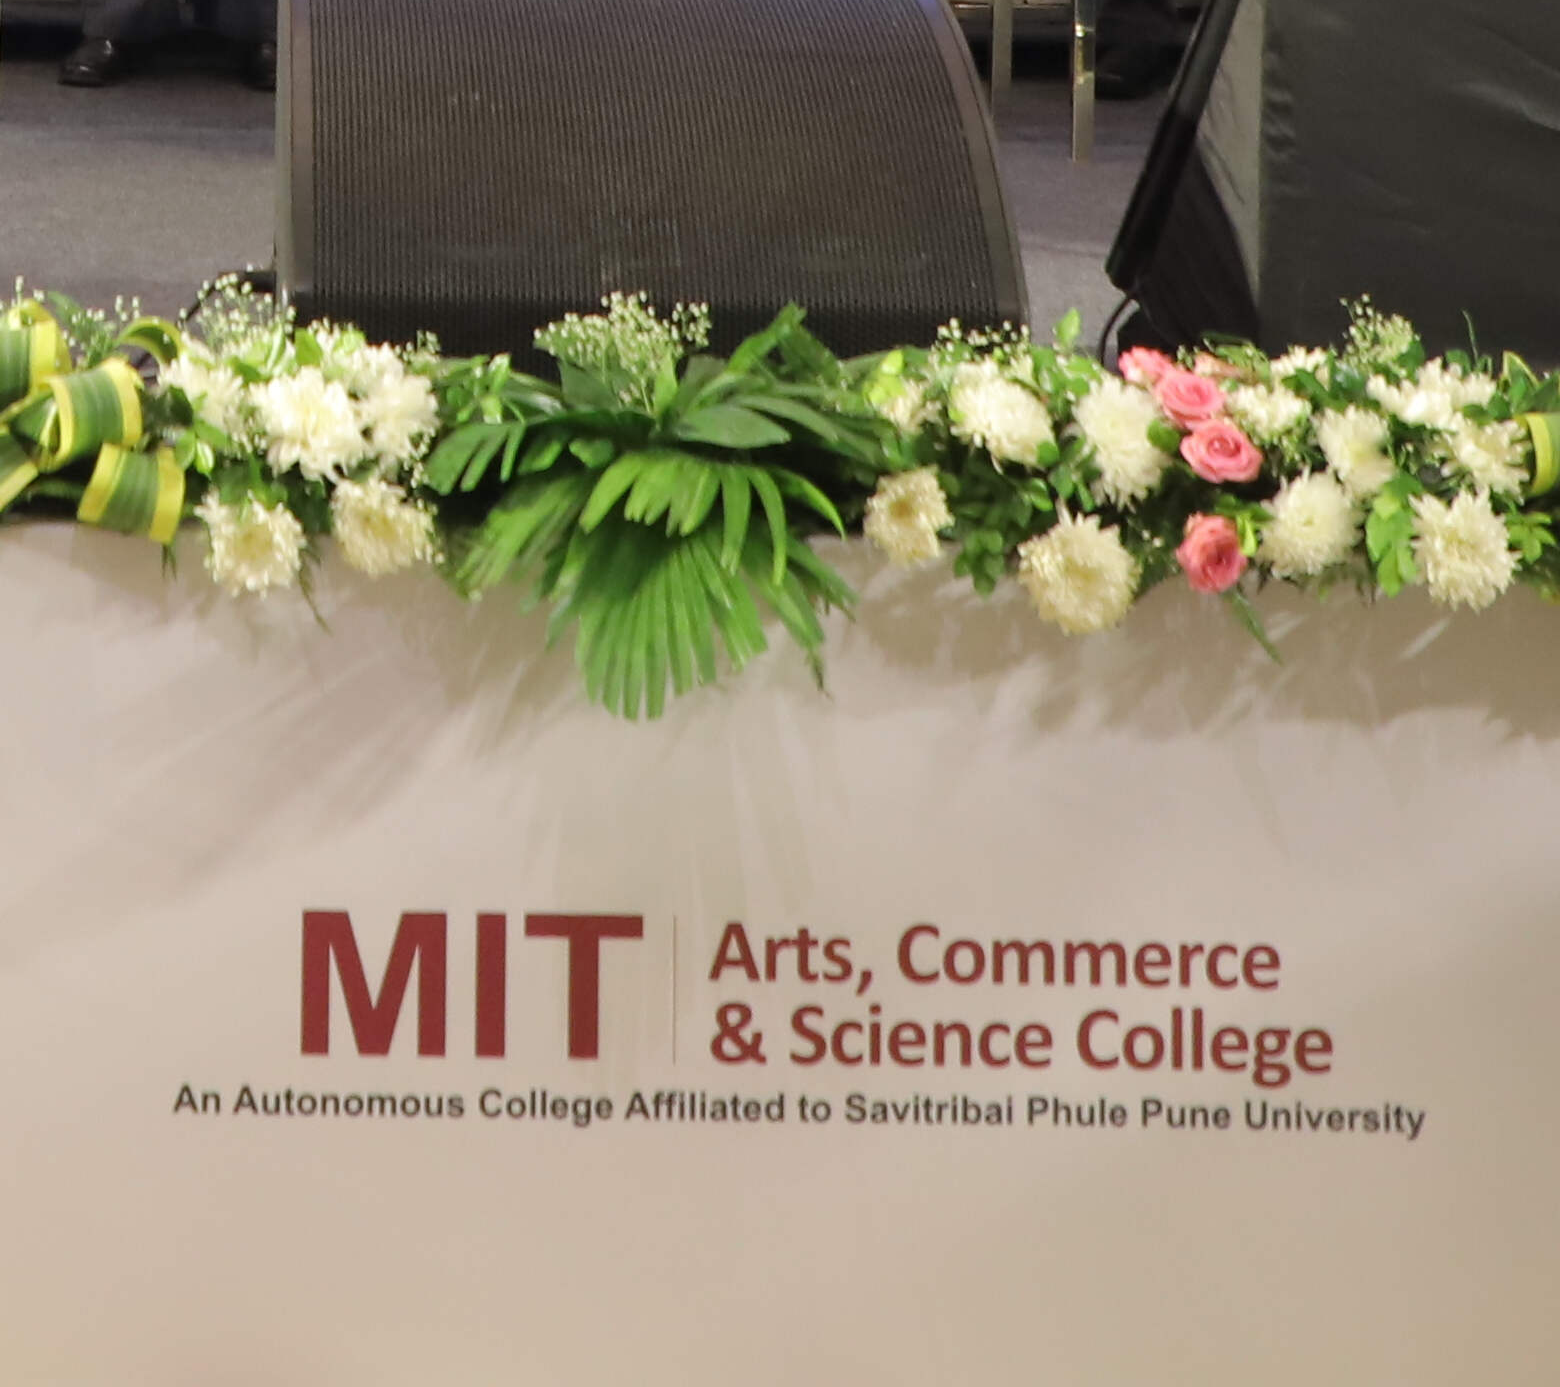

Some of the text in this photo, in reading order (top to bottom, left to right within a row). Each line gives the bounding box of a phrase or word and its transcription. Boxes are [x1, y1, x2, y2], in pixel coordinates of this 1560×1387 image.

[298, 909, 643, 1061] MIT
[707, 922, 1282, 995] Arts, Commerce
[709, 1003, 1335, 1091] & Science College
[173, 1085, 1425, 1142] An Autonomous College Affiliated to Savitribai Phule Pune University
